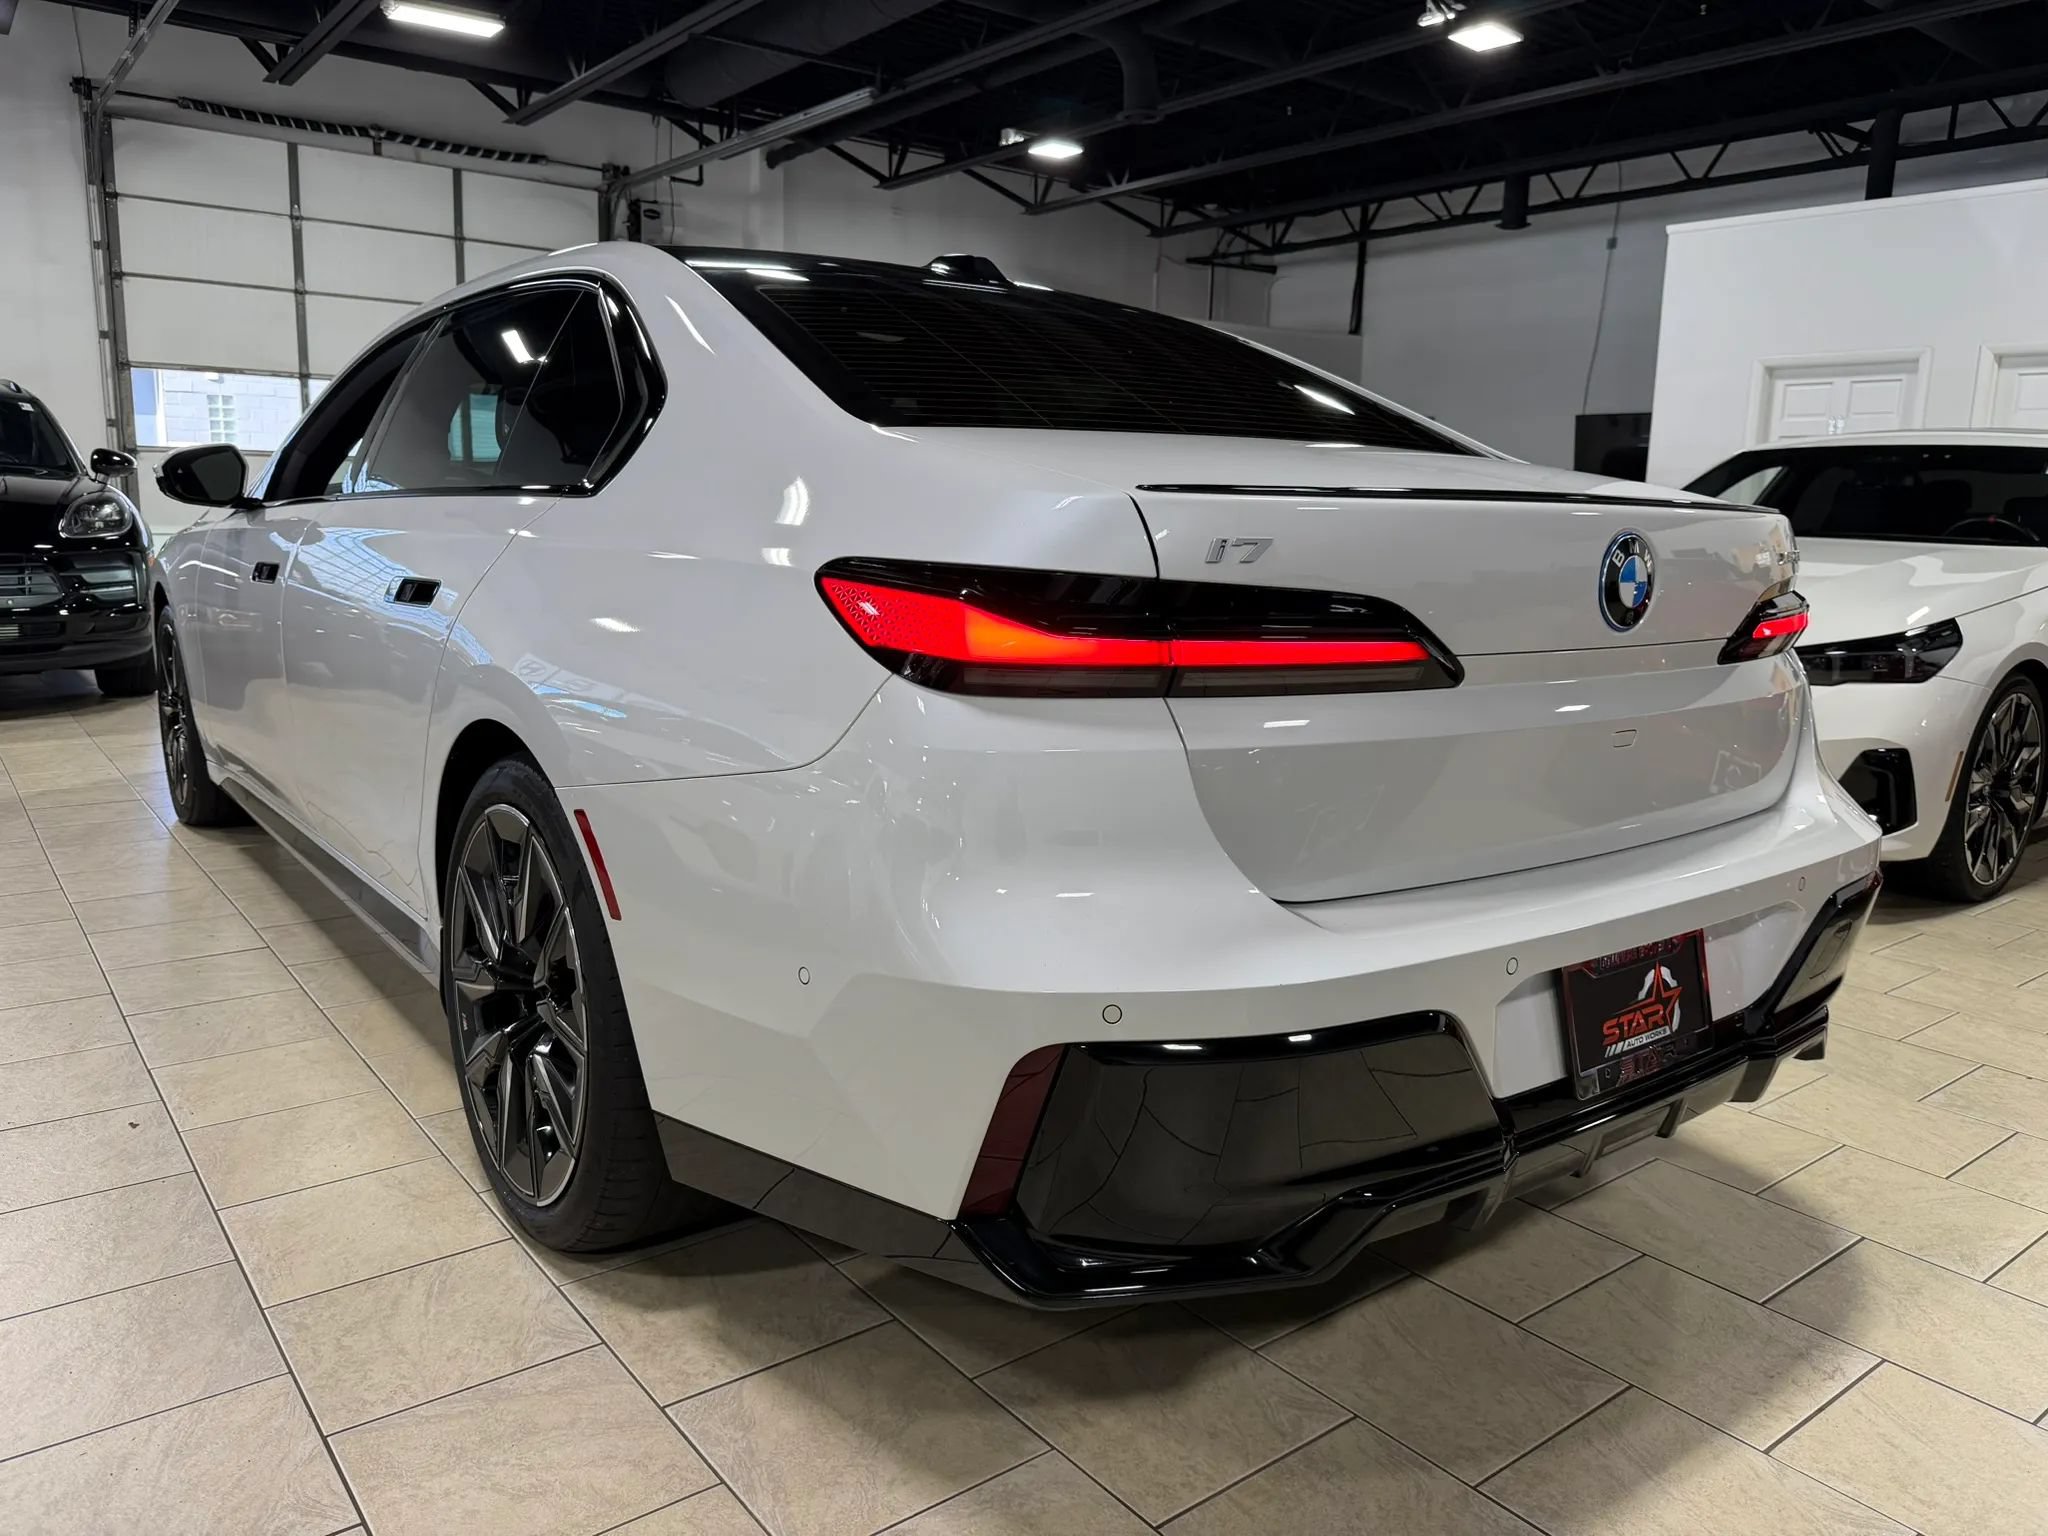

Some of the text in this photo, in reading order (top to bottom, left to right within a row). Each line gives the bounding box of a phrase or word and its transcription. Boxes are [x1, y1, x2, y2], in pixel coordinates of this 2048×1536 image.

[1205, 537, 1274, 564] i7
[1611, 539, 1652, 573] BMW
[1602, 1004, 1665, 1047] STAR
[1626, 1027, 1668, 1049] AUTO WORKS
